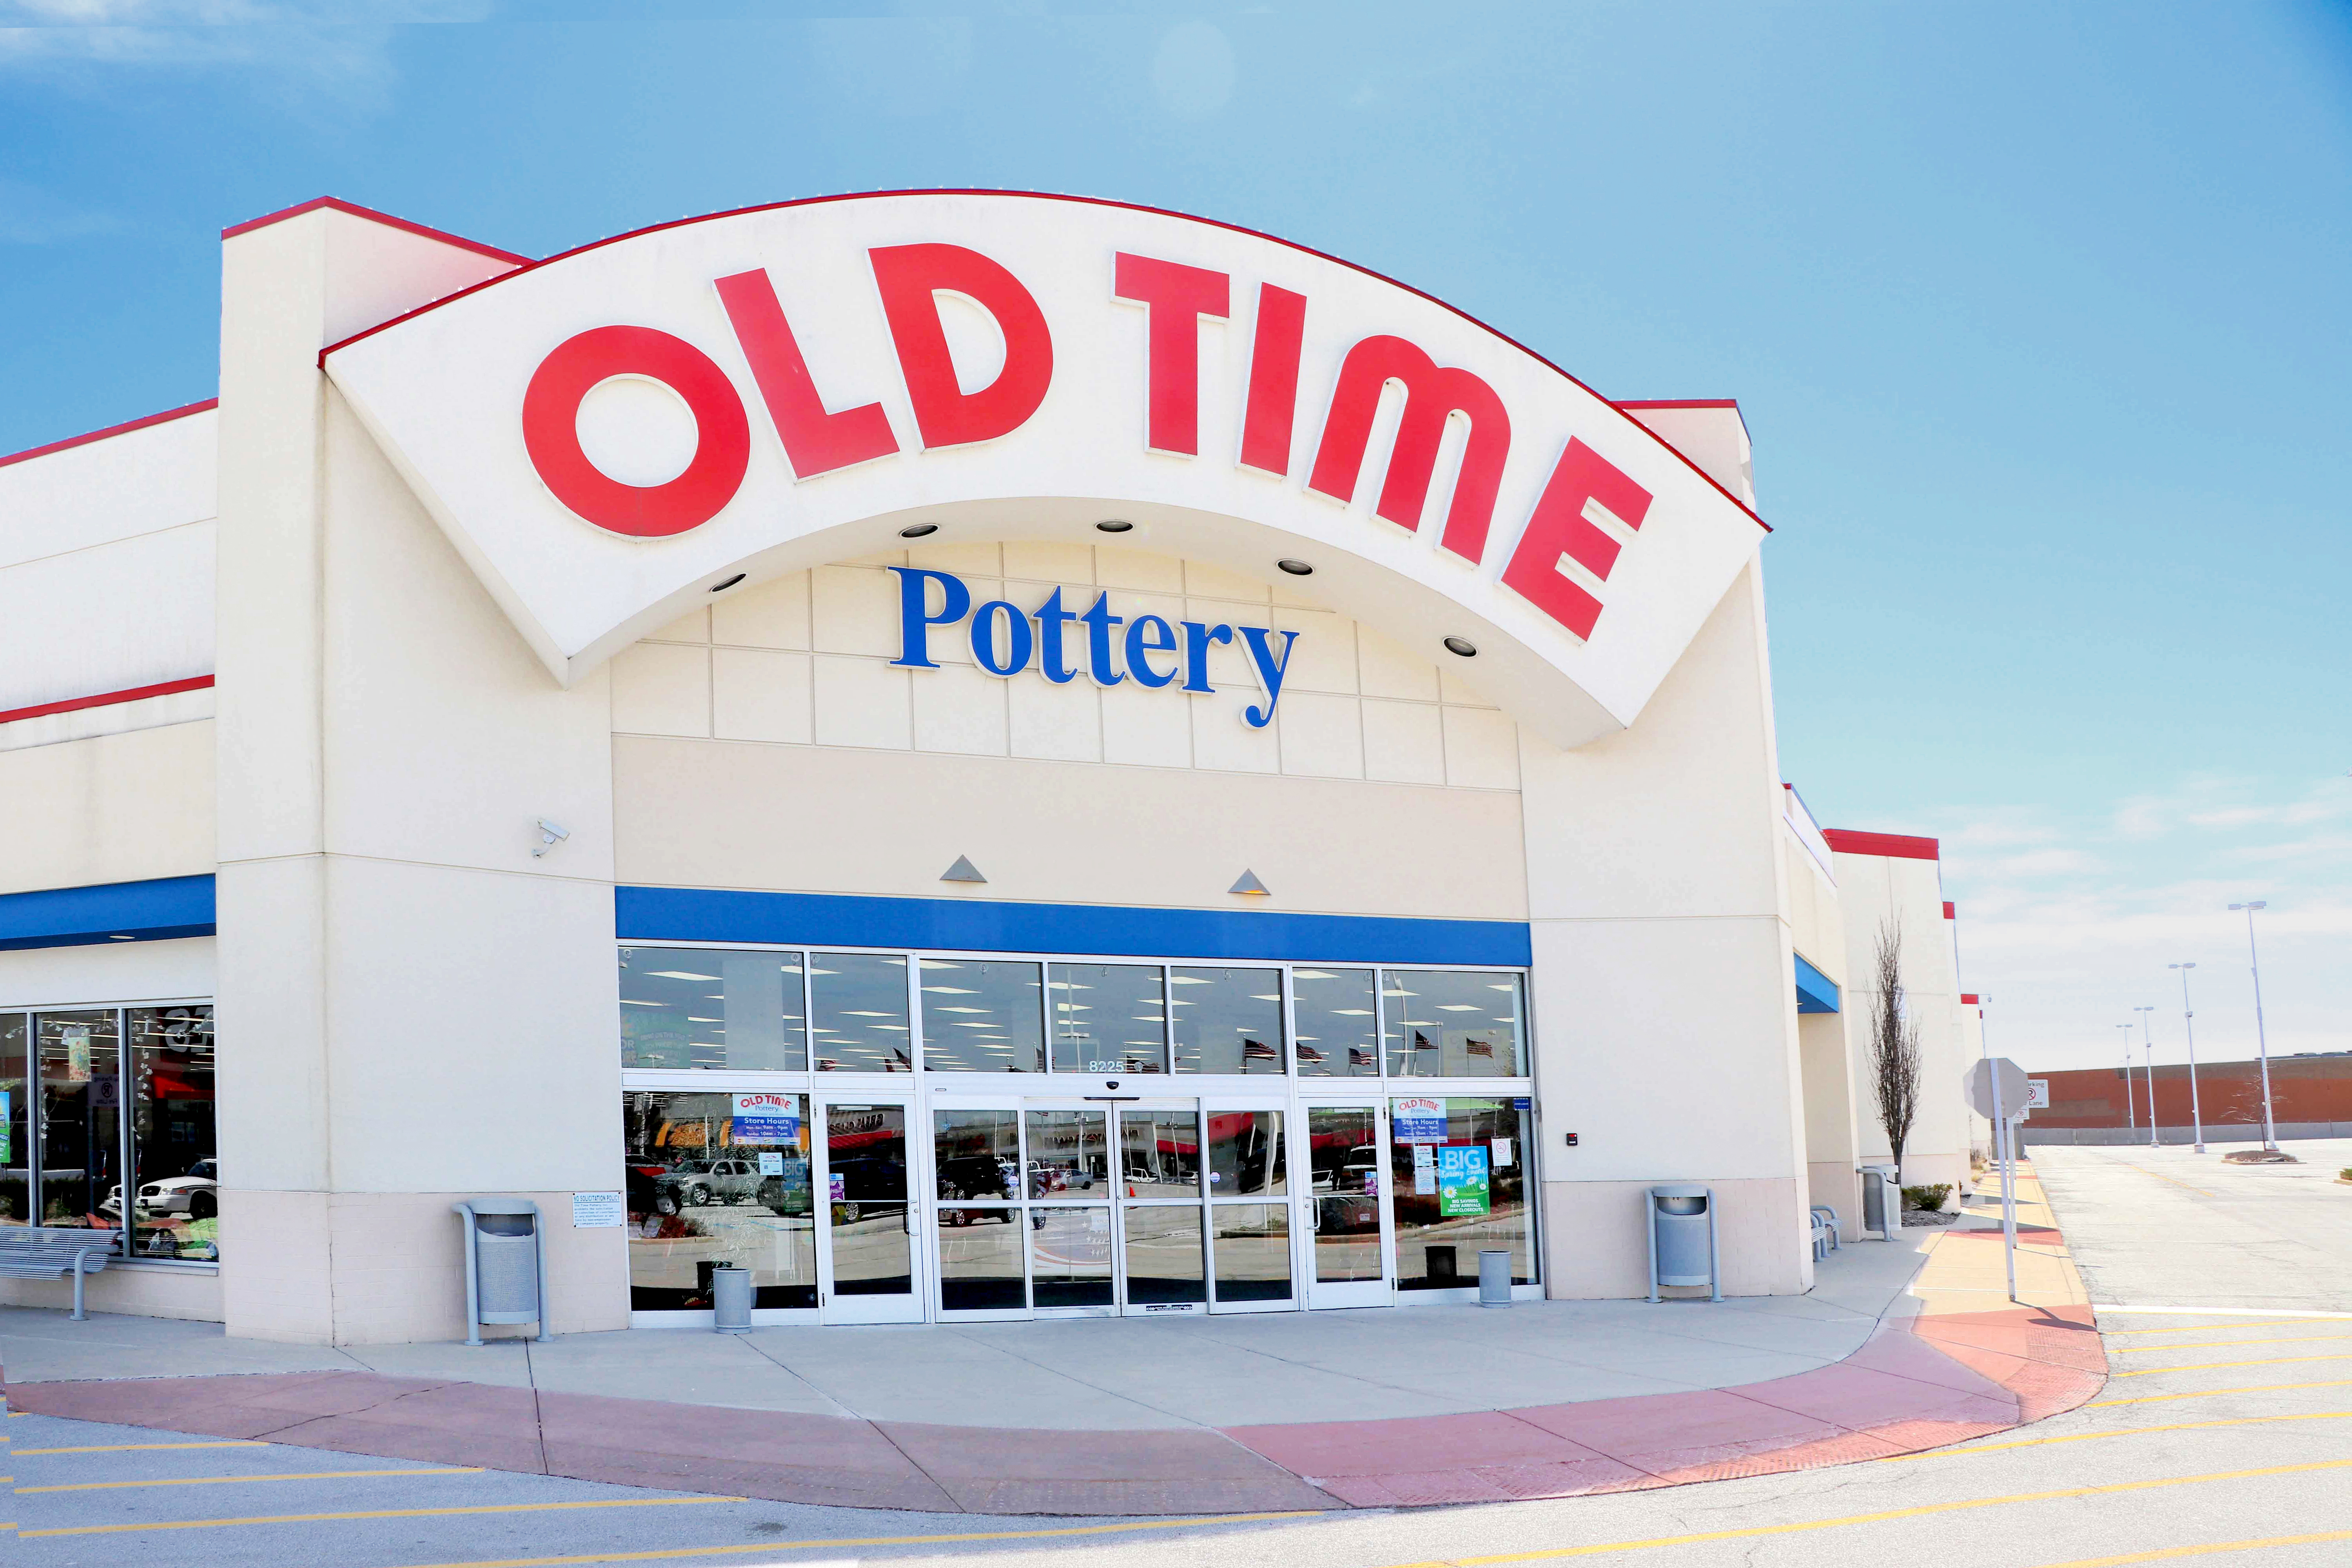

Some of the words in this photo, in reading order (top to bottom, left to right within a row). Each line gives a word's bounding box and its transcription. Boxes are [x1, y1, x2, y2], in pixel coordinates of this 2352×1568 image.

[521, 242, 1054, 538] OLD
[1114, 252, 1653, 641] TIME
[889, 567, 1299, 727] Pottery
[1089, 1060, 1124, 1073] 8225
[740, 1096, 763, 1107] OLD
[765, 1095, 792, 1110] TIME
[1399, 1100, 1417, 1110] OLD
[1419, 1099, 1439, 1111] TIME
[1445, 1150, 1481, 1169] BIG
[784, 1160, 804, 1176] BIG
[1441, 1170, 1464, 1180] Spring
[1466, 1167, 1486, 1175] Event
